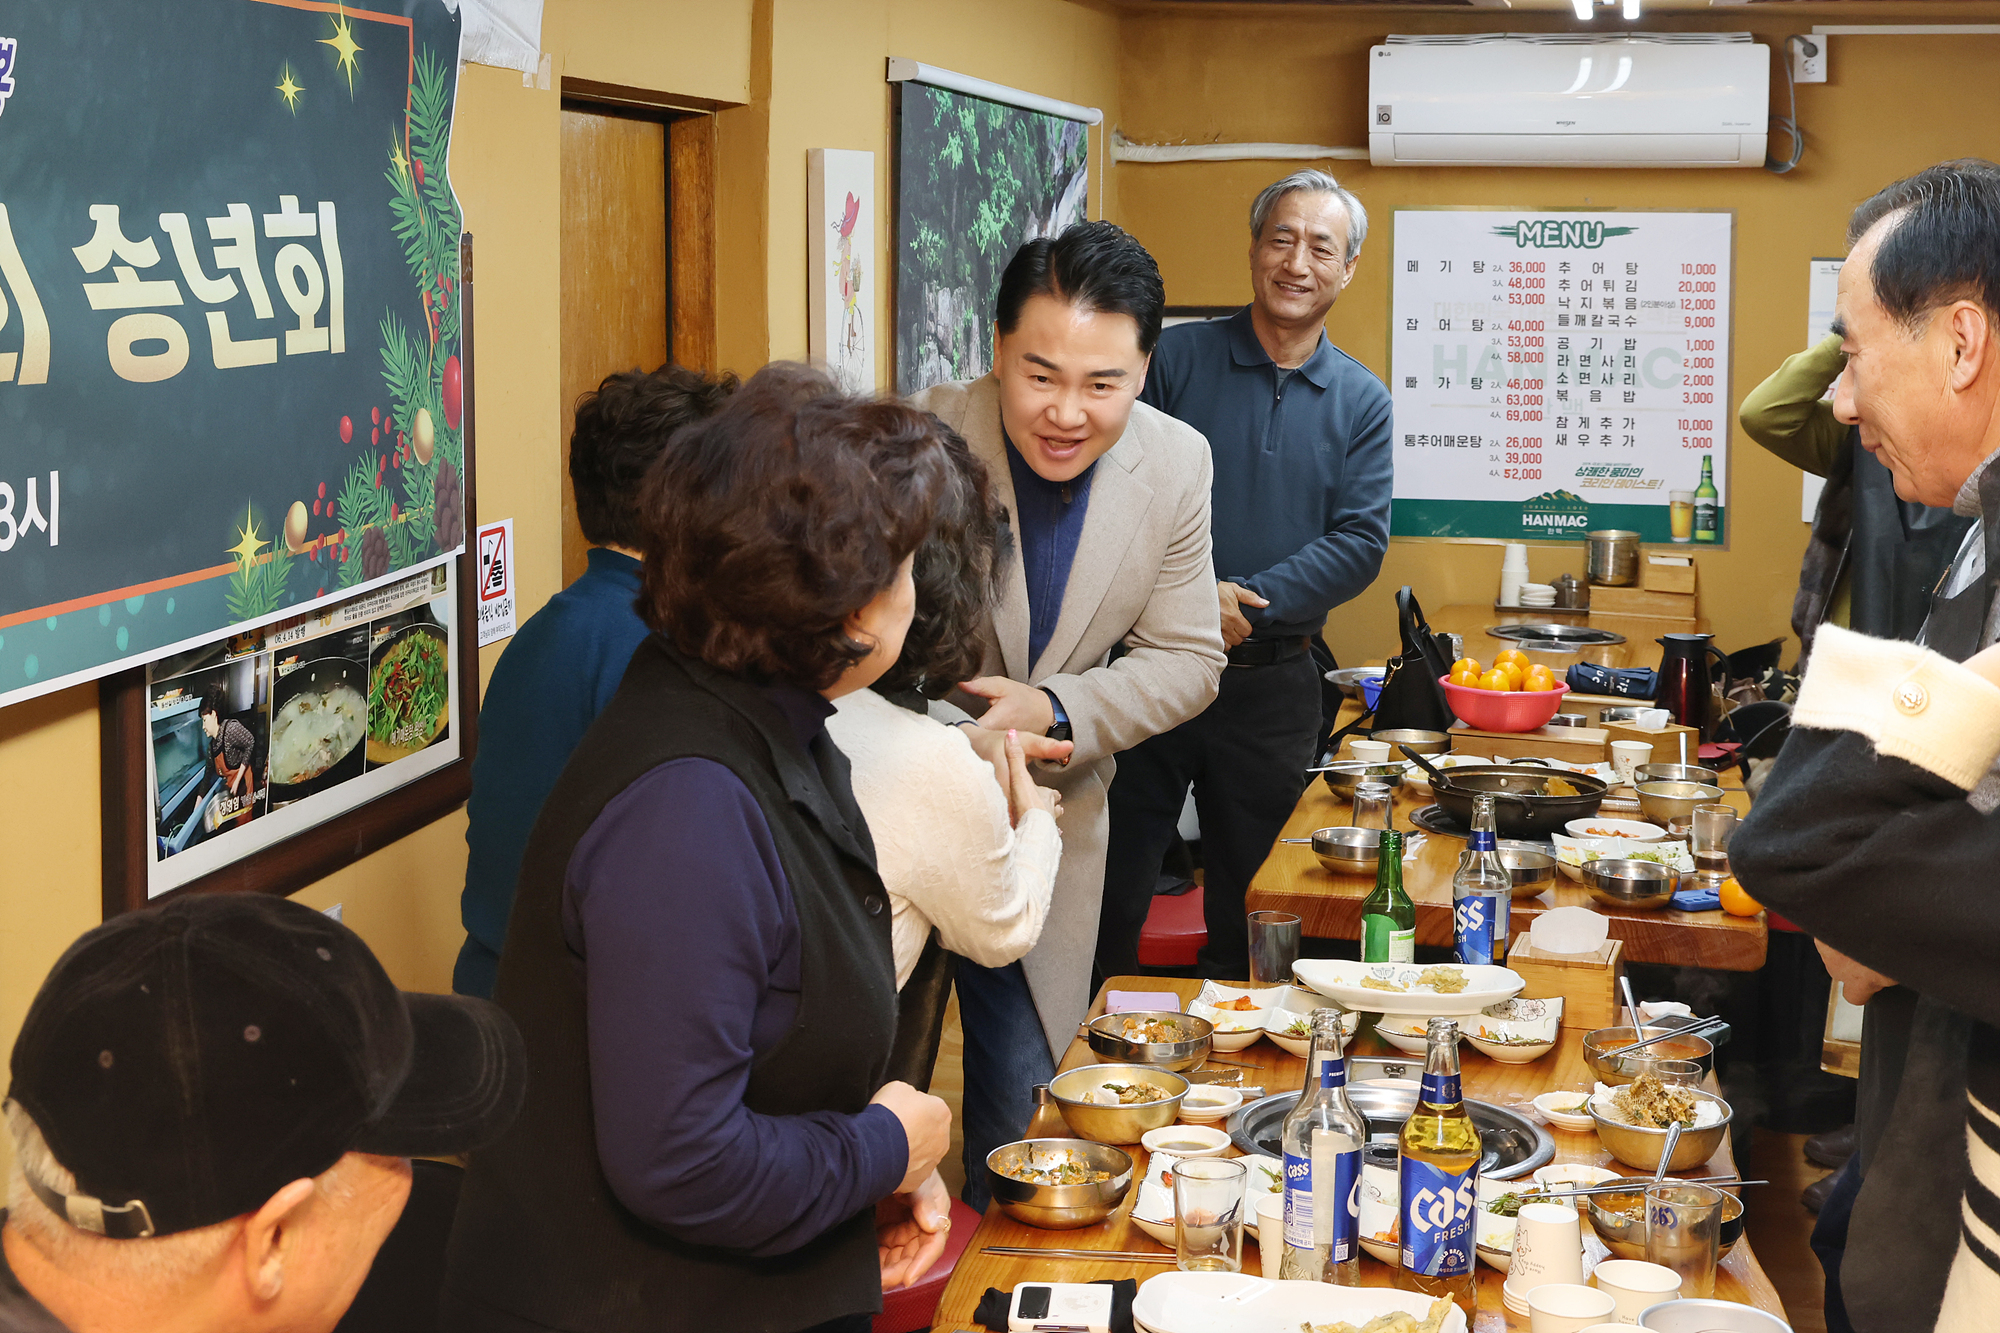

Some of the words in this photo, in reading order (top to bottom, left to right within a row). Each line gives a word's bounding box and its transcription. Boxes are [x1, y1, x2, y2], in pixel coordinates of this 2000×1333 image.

[1516, 220, 1604, 248] MENU
[1509, 262, 1545, 274] 36,000
[1681, 264, 1716, 276] 10,000
[73, 195, 345, 383] 송년회
[1508, 278, 1545, 290] 48,000
[1679, 281, 1715, 293] 20,000
[1508, 294, 1545, 306] 53,000
[1680, 299, 1715, 311] 12,000
[1508, 320, 1544, 332] 40,000
[1685, 317, 1714, 329] 9,000
[1508, 336, 1544, 348] 53,000
[1687, 340, 1714, 352] 1,000
[1507, 352, 1544, 364] 58,000
[1683, 357, 1714, 369] 2,000
[1507, 378, 1543, 390] 46,000
[1683, 375, 1713, 387] 2,000
[1507, 394, 1543, 406] 63,000
[1683, 392, 1713, 404] 3,000
[1506, 410, 1542, 422] 69,000
[1678, 419, 1712, 431] 10,000
[1405, 435, 1482, 448] 통추어매운탕
[1506, 437, 1542, 449] 26,000
[1682, 437, 1712, 449] 5,000
[1505, 453, 1542, 465] 39,000
[1504, 469, 1541, 481] 52,000
[1575, 466, 1609, 476] 상쾌한
[1609, 467, 1643, 477] 풍미의
[1579, 477, 1614, 488] 코리안
[1522, 514, 1587, 526] HANMAC
[1434, 1219, 1472, 1244] FRESH
